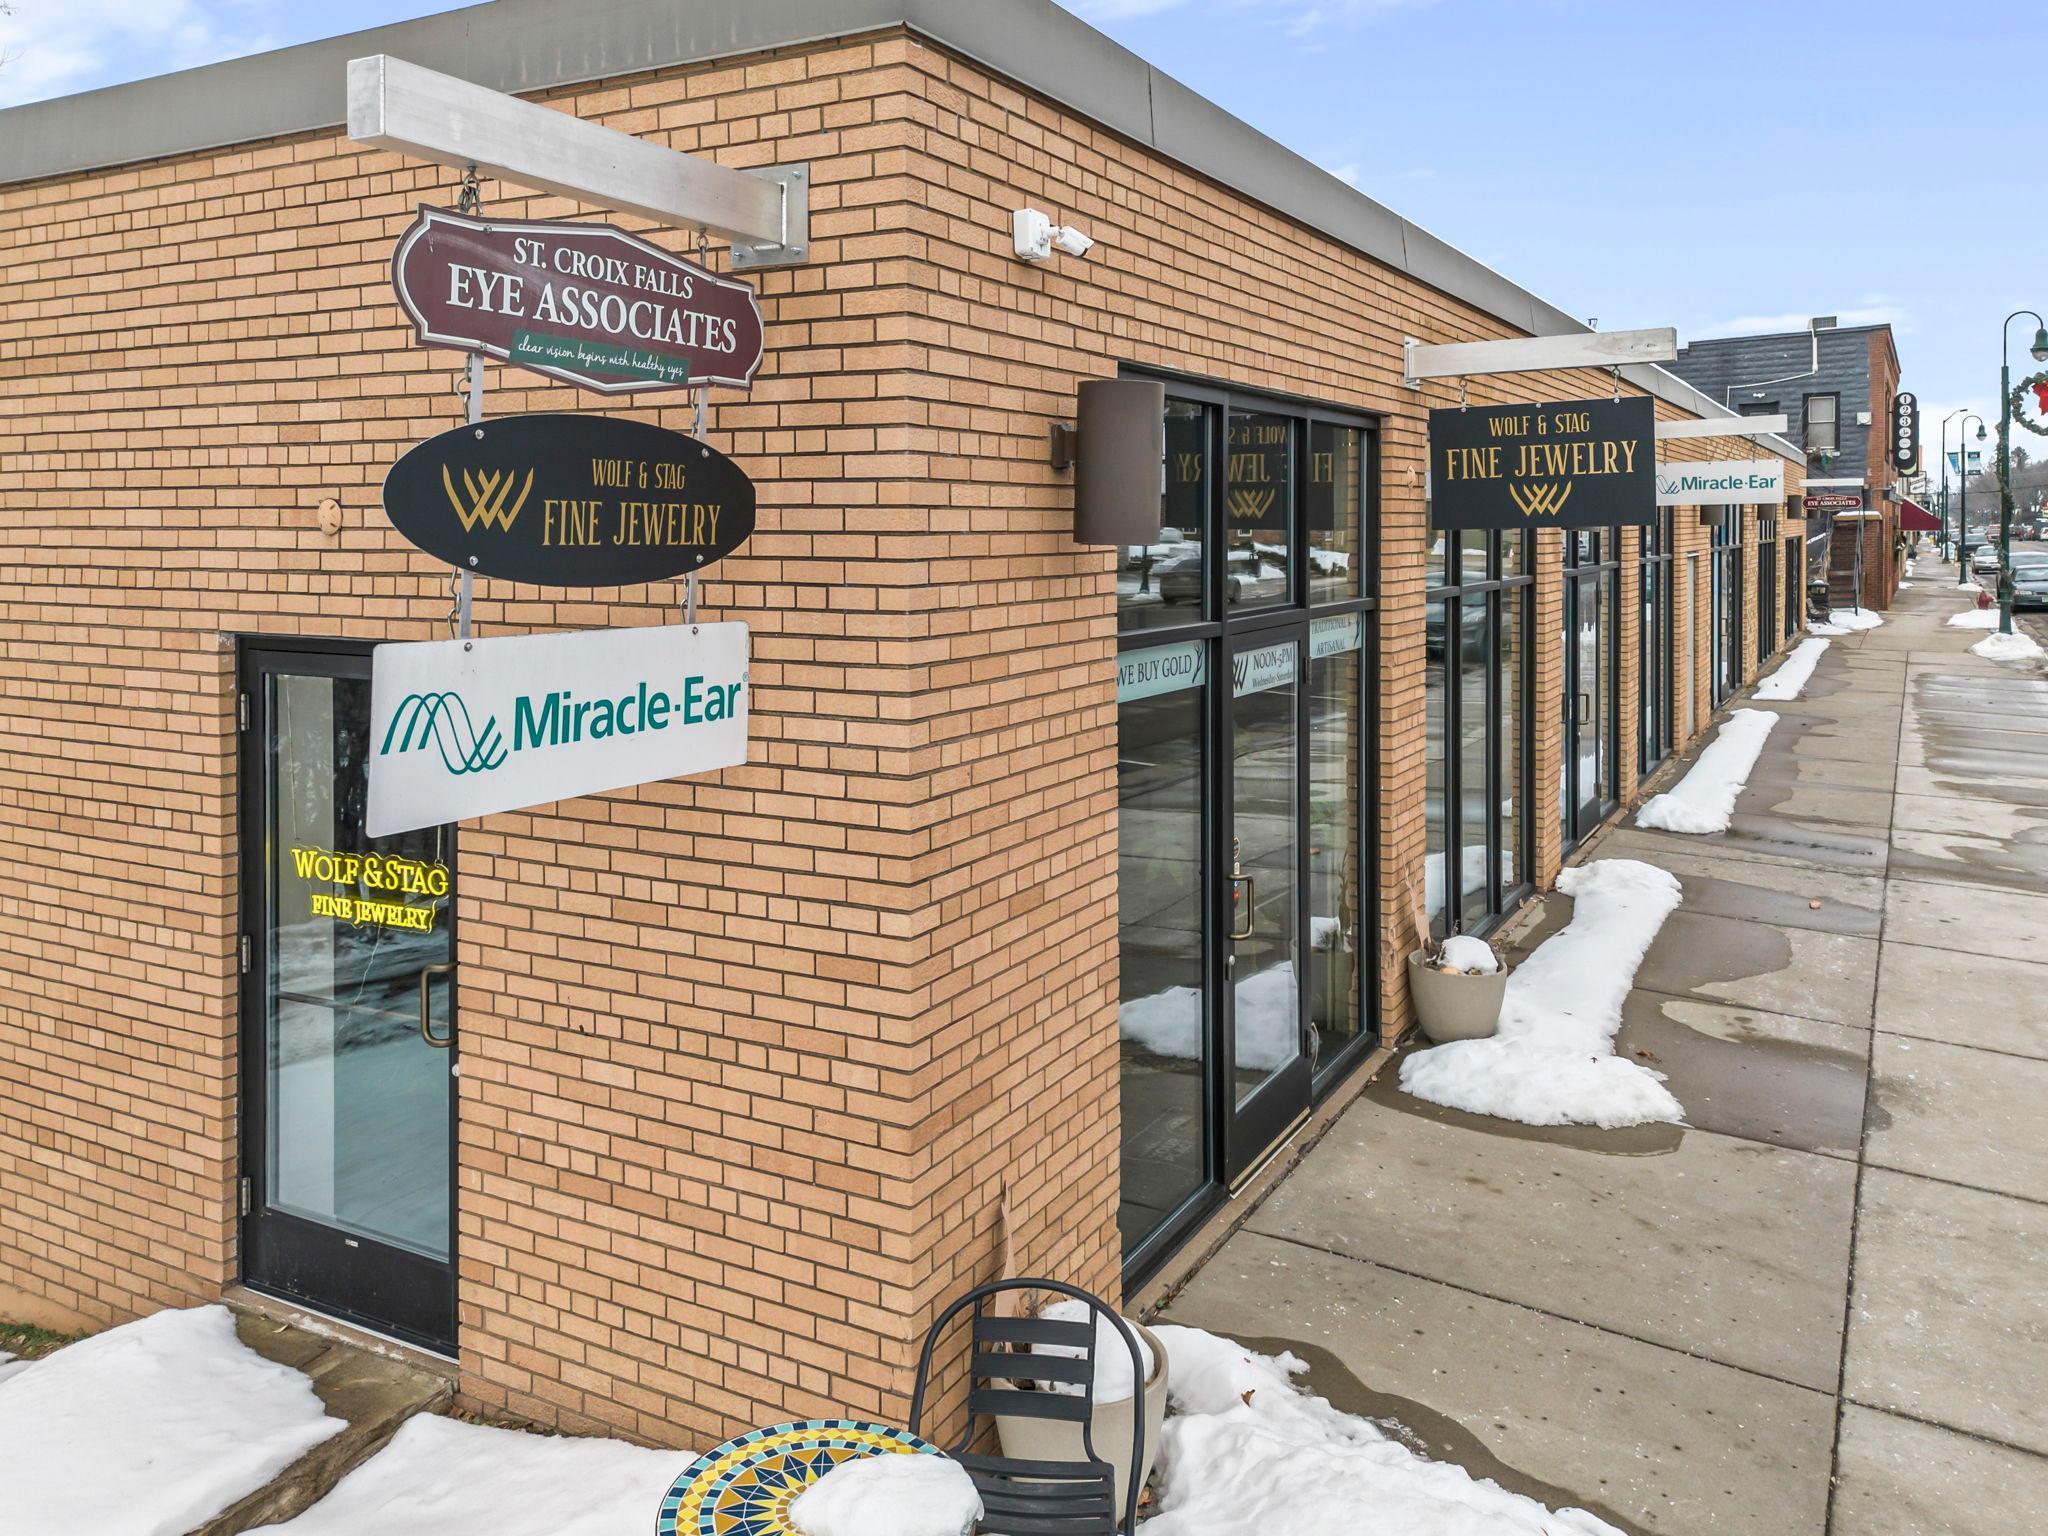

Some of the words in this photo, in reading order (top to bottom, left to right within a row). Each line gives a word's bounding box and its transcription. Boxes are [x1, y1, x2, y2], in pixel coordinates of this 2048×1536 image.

[513, 237, 547, 269] ST.
[554, 247, 630, 286] CROIX
[634, 265, 694, 299] FALLS
[445, 262, 525, 318] EYE
[533, 281, 737, 354] ASSOCIATES
[518, 334, 543, 354] clear
[546, 346, 575, 358] vision
[577, 344, 607, 367] begins
[609, 350, 630, 367] with
[632, 352, 665, 378] healthy
[667, 365, 684, 380] eyes
[1488, 415, 1531, 437] WOLF
[1538, 414, 1547, 435] &
[1555, 412, 1590, 434] STAG
[592, 458, 634, 488] WOLF
[639, 462, 648, 489] &
[655, 463, 686, 490] STAG
[1446, 446, 1503, 480] FINE
[1514, 440, 1637, 477] JEWELRY
[541, 499, 603, 546] FINE
[613, 502, 721, 547] JEWELRY
[1117, 664, 1134, 687] WE
[1138, 660, 1160, 683] BUY
[1162, 654, 1192, 678] GOLD
[292, 848, 359, 884] WOLF
[363, 857, 385, 889] &
[385, 860, 449, 896] STAG
[311, 894, 352, 919] FINE
[353, 900, 430, 930] JEWELRY
